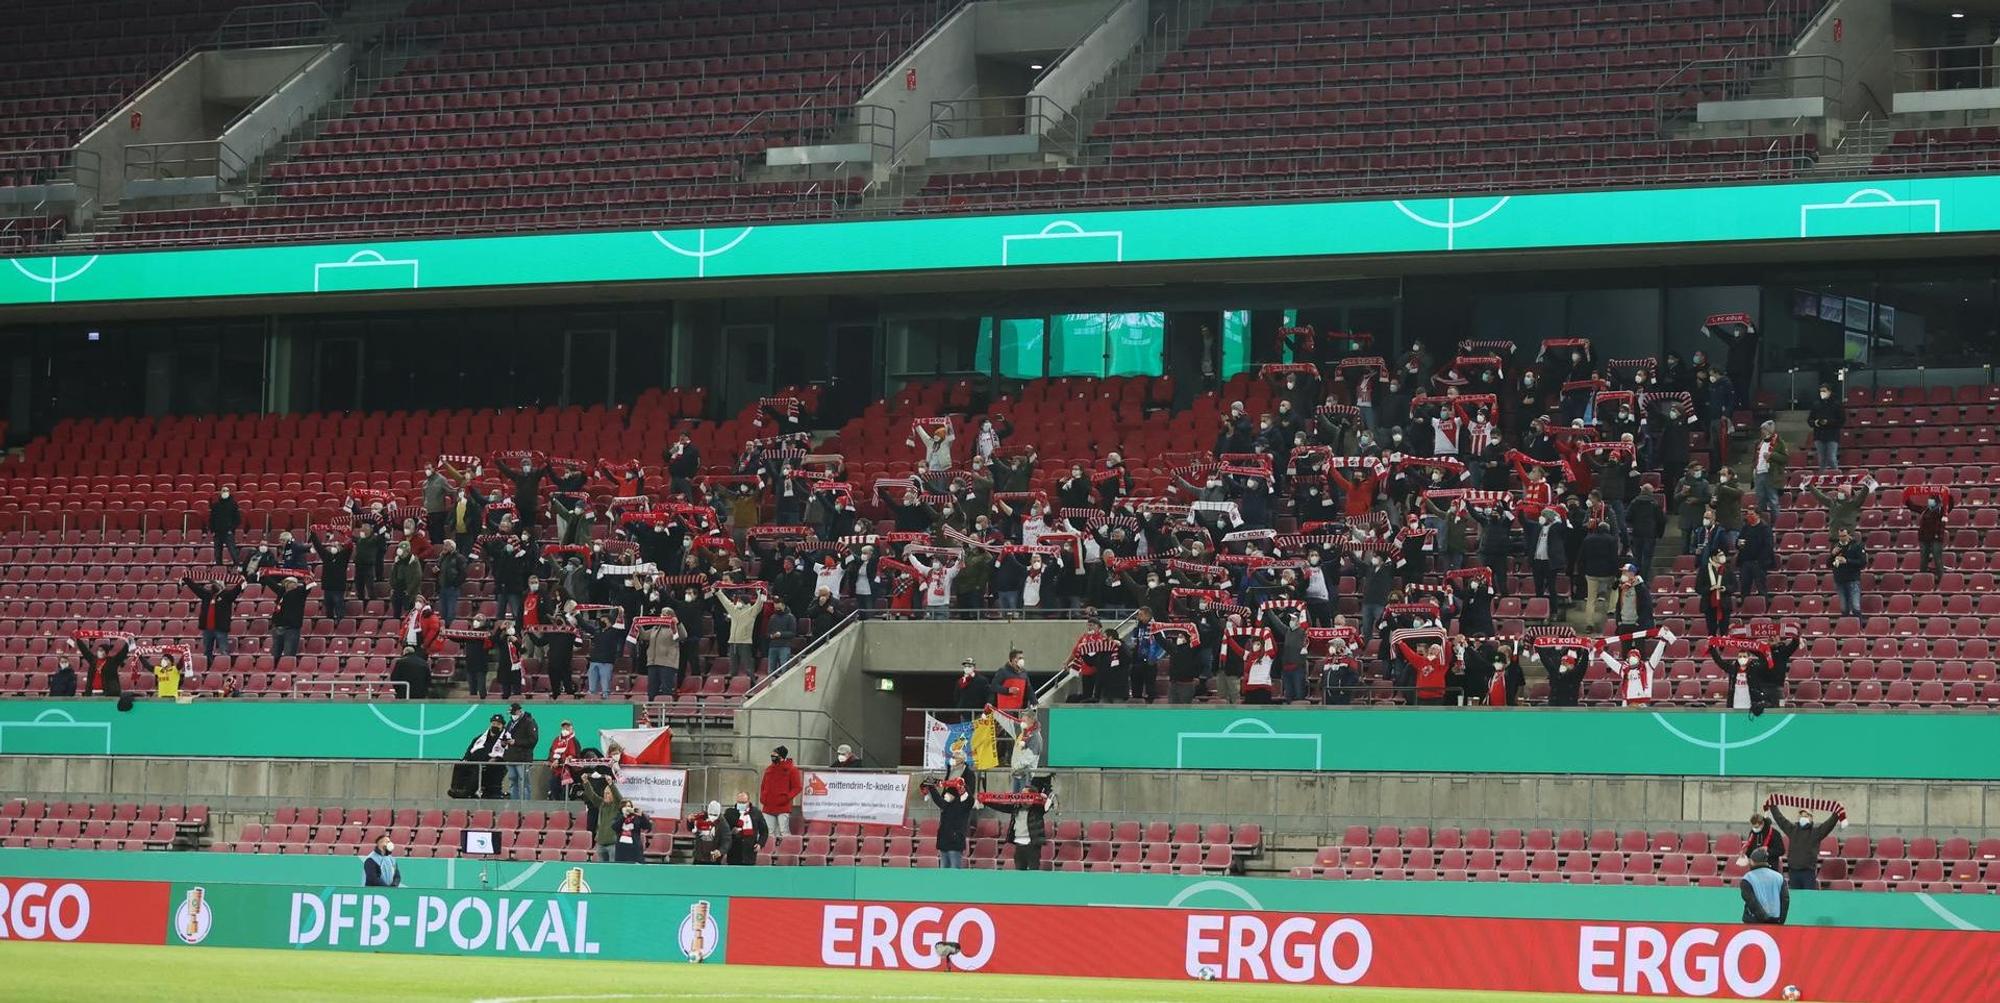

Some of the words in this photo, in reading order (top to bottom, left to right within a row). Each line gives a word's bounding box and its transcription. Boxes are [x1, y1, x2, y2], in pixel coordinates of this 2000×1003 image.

[289, 893, 600, 953] DFB-POKAL
[822, 905, 996, 971] ERGO
[1186, 915, 1373, 984] ERGO
[1578, 926, 1781, 997] ERGO
